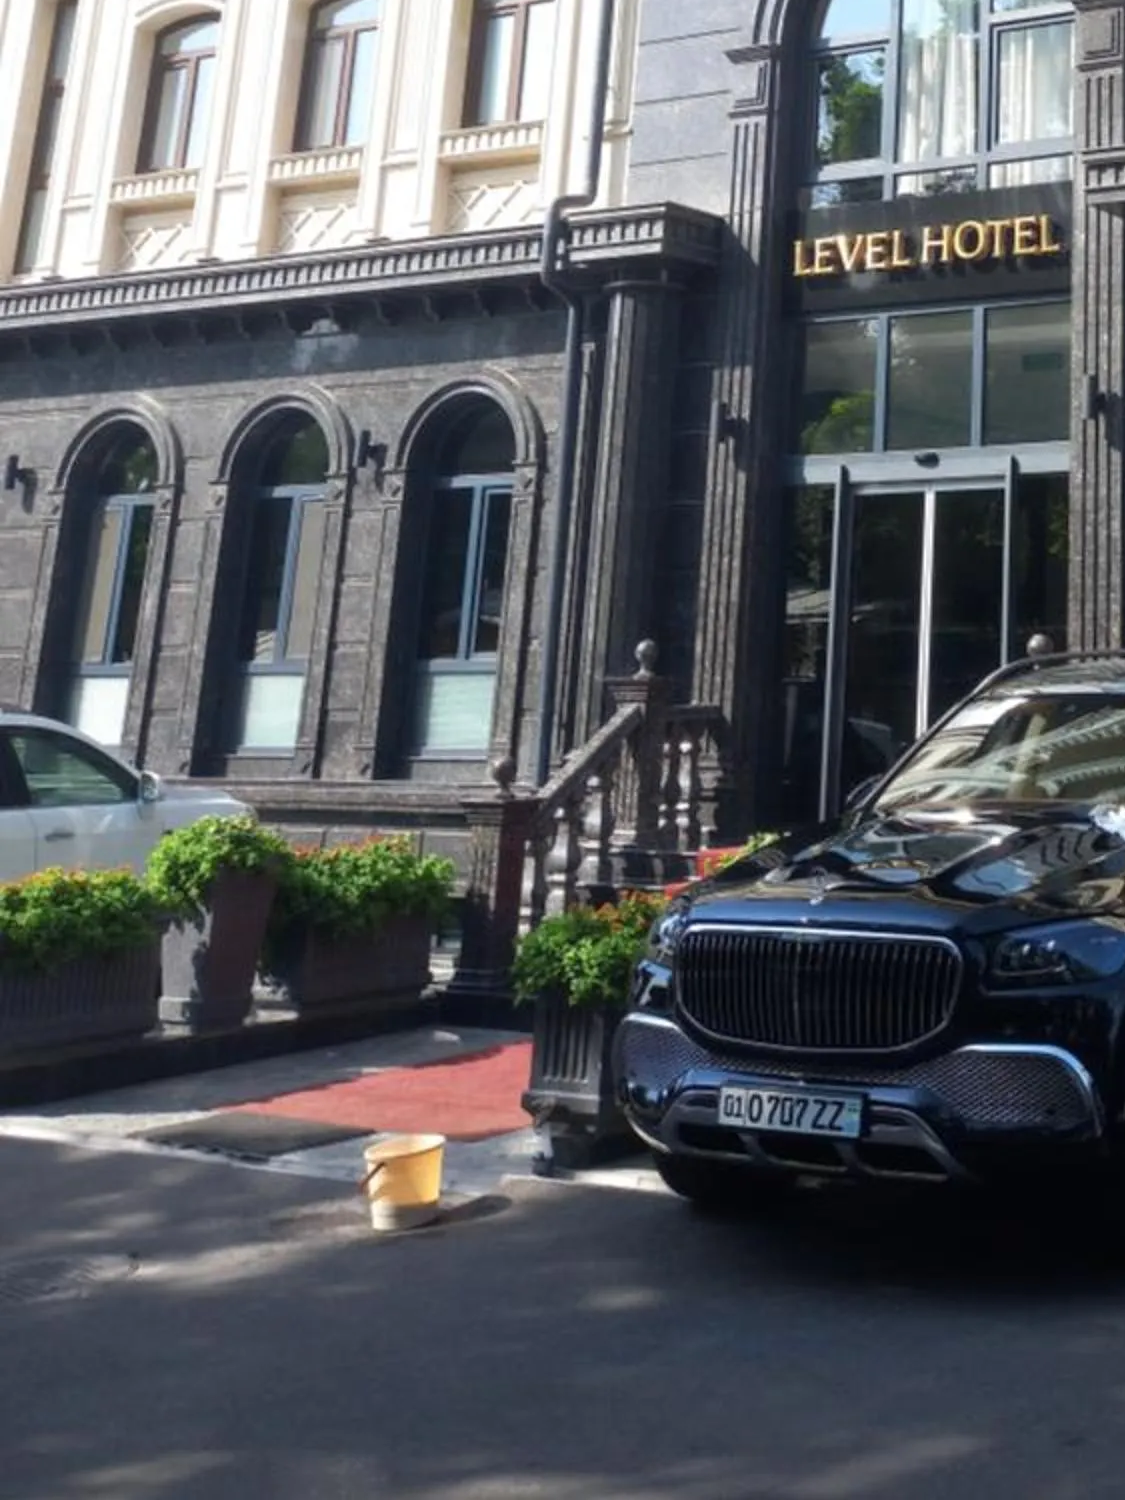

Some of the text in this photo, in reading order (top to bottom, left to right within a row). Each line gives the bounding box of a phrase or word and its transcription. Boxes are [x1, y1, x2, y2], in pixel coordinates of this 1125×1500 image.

[793, 214, 1061, 276] LEVEL HOTEL
[723, 1093, 743, 1119] 01
